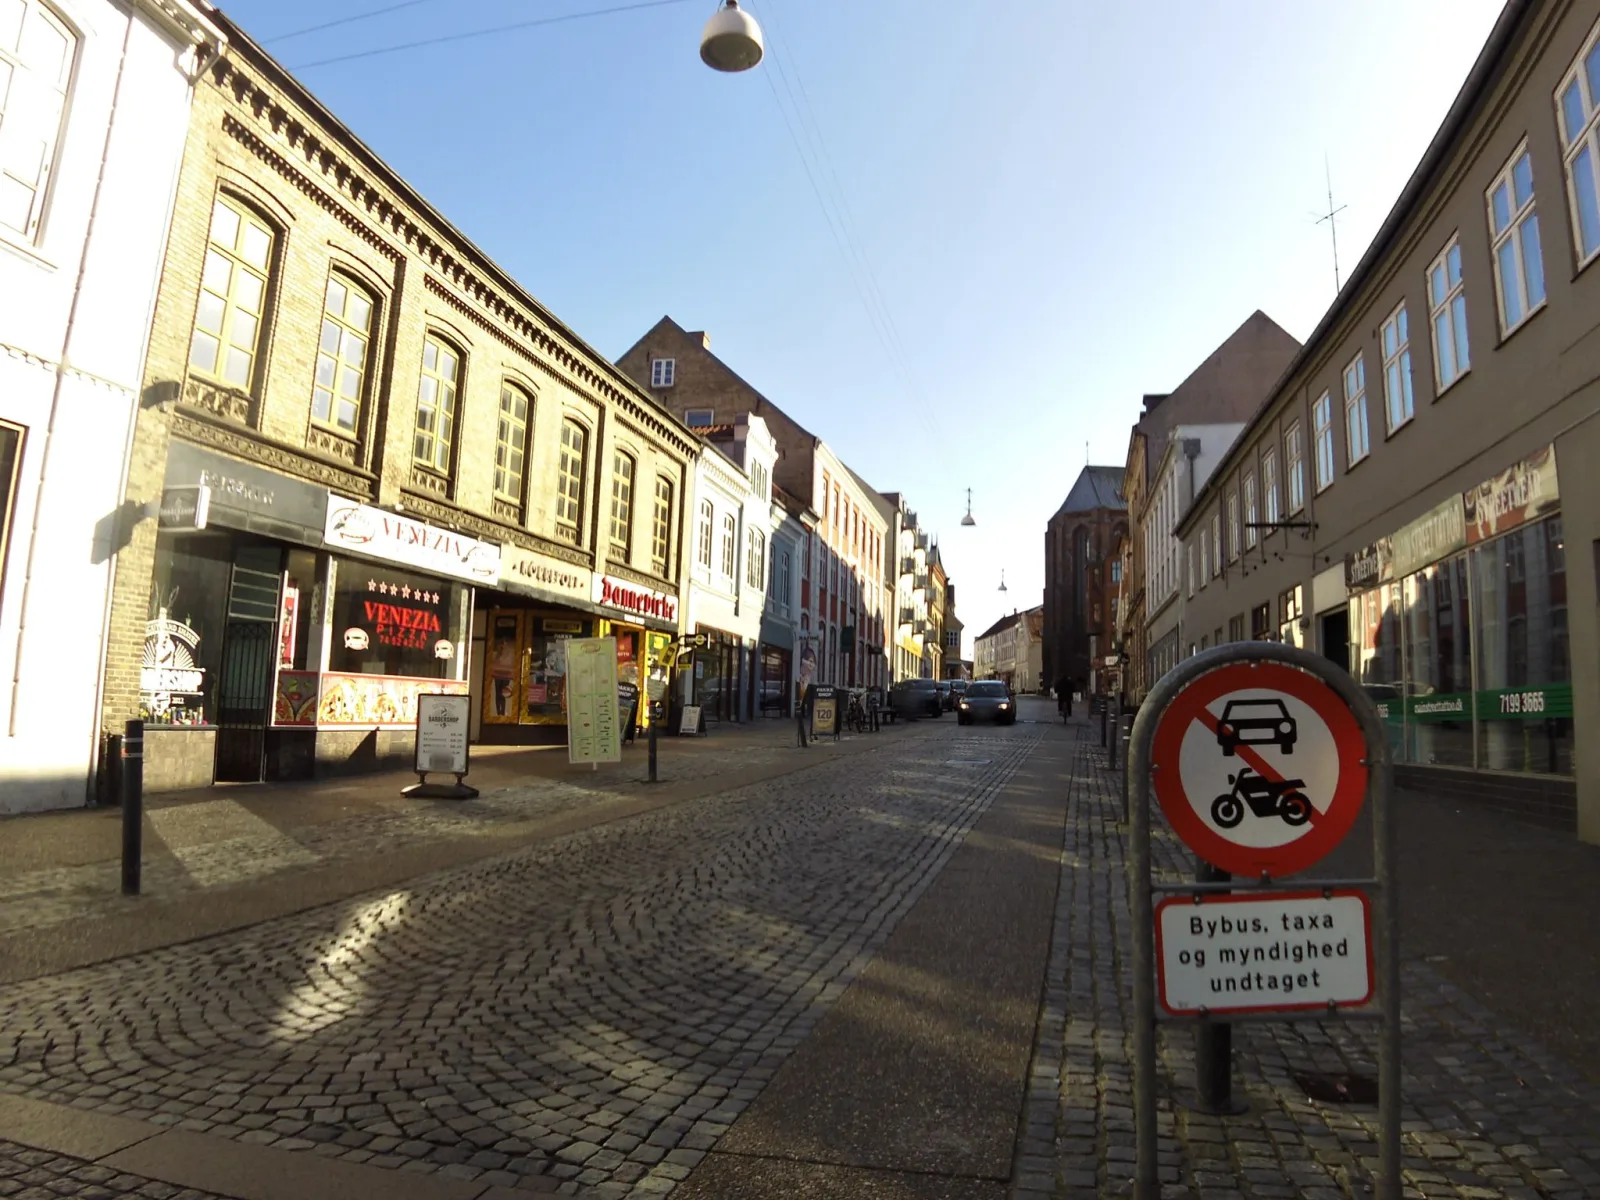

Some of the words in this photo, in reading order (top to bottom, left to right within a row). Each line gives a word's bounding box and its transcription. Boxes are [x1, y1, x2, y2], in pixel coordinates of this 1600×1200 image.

[382, 517, 461, 557] VENEZIA
[600, 576, 676, 620] Dannevirke
[364, 601, 440, 632] VENEZIA
[376, 624, 428, 641] PIZZA
[816, 709, 832, 719] 120
[1500, 694, 1521, 713] 7199
[1521, 692, 1544, 713] 3665
[1282, 913, 1334, 931] taxa
[1179, 950, 1206, 967] og
[1219, 938, 1349, 966] myndighed
[1211, 968, 1321, 993] undtaget
